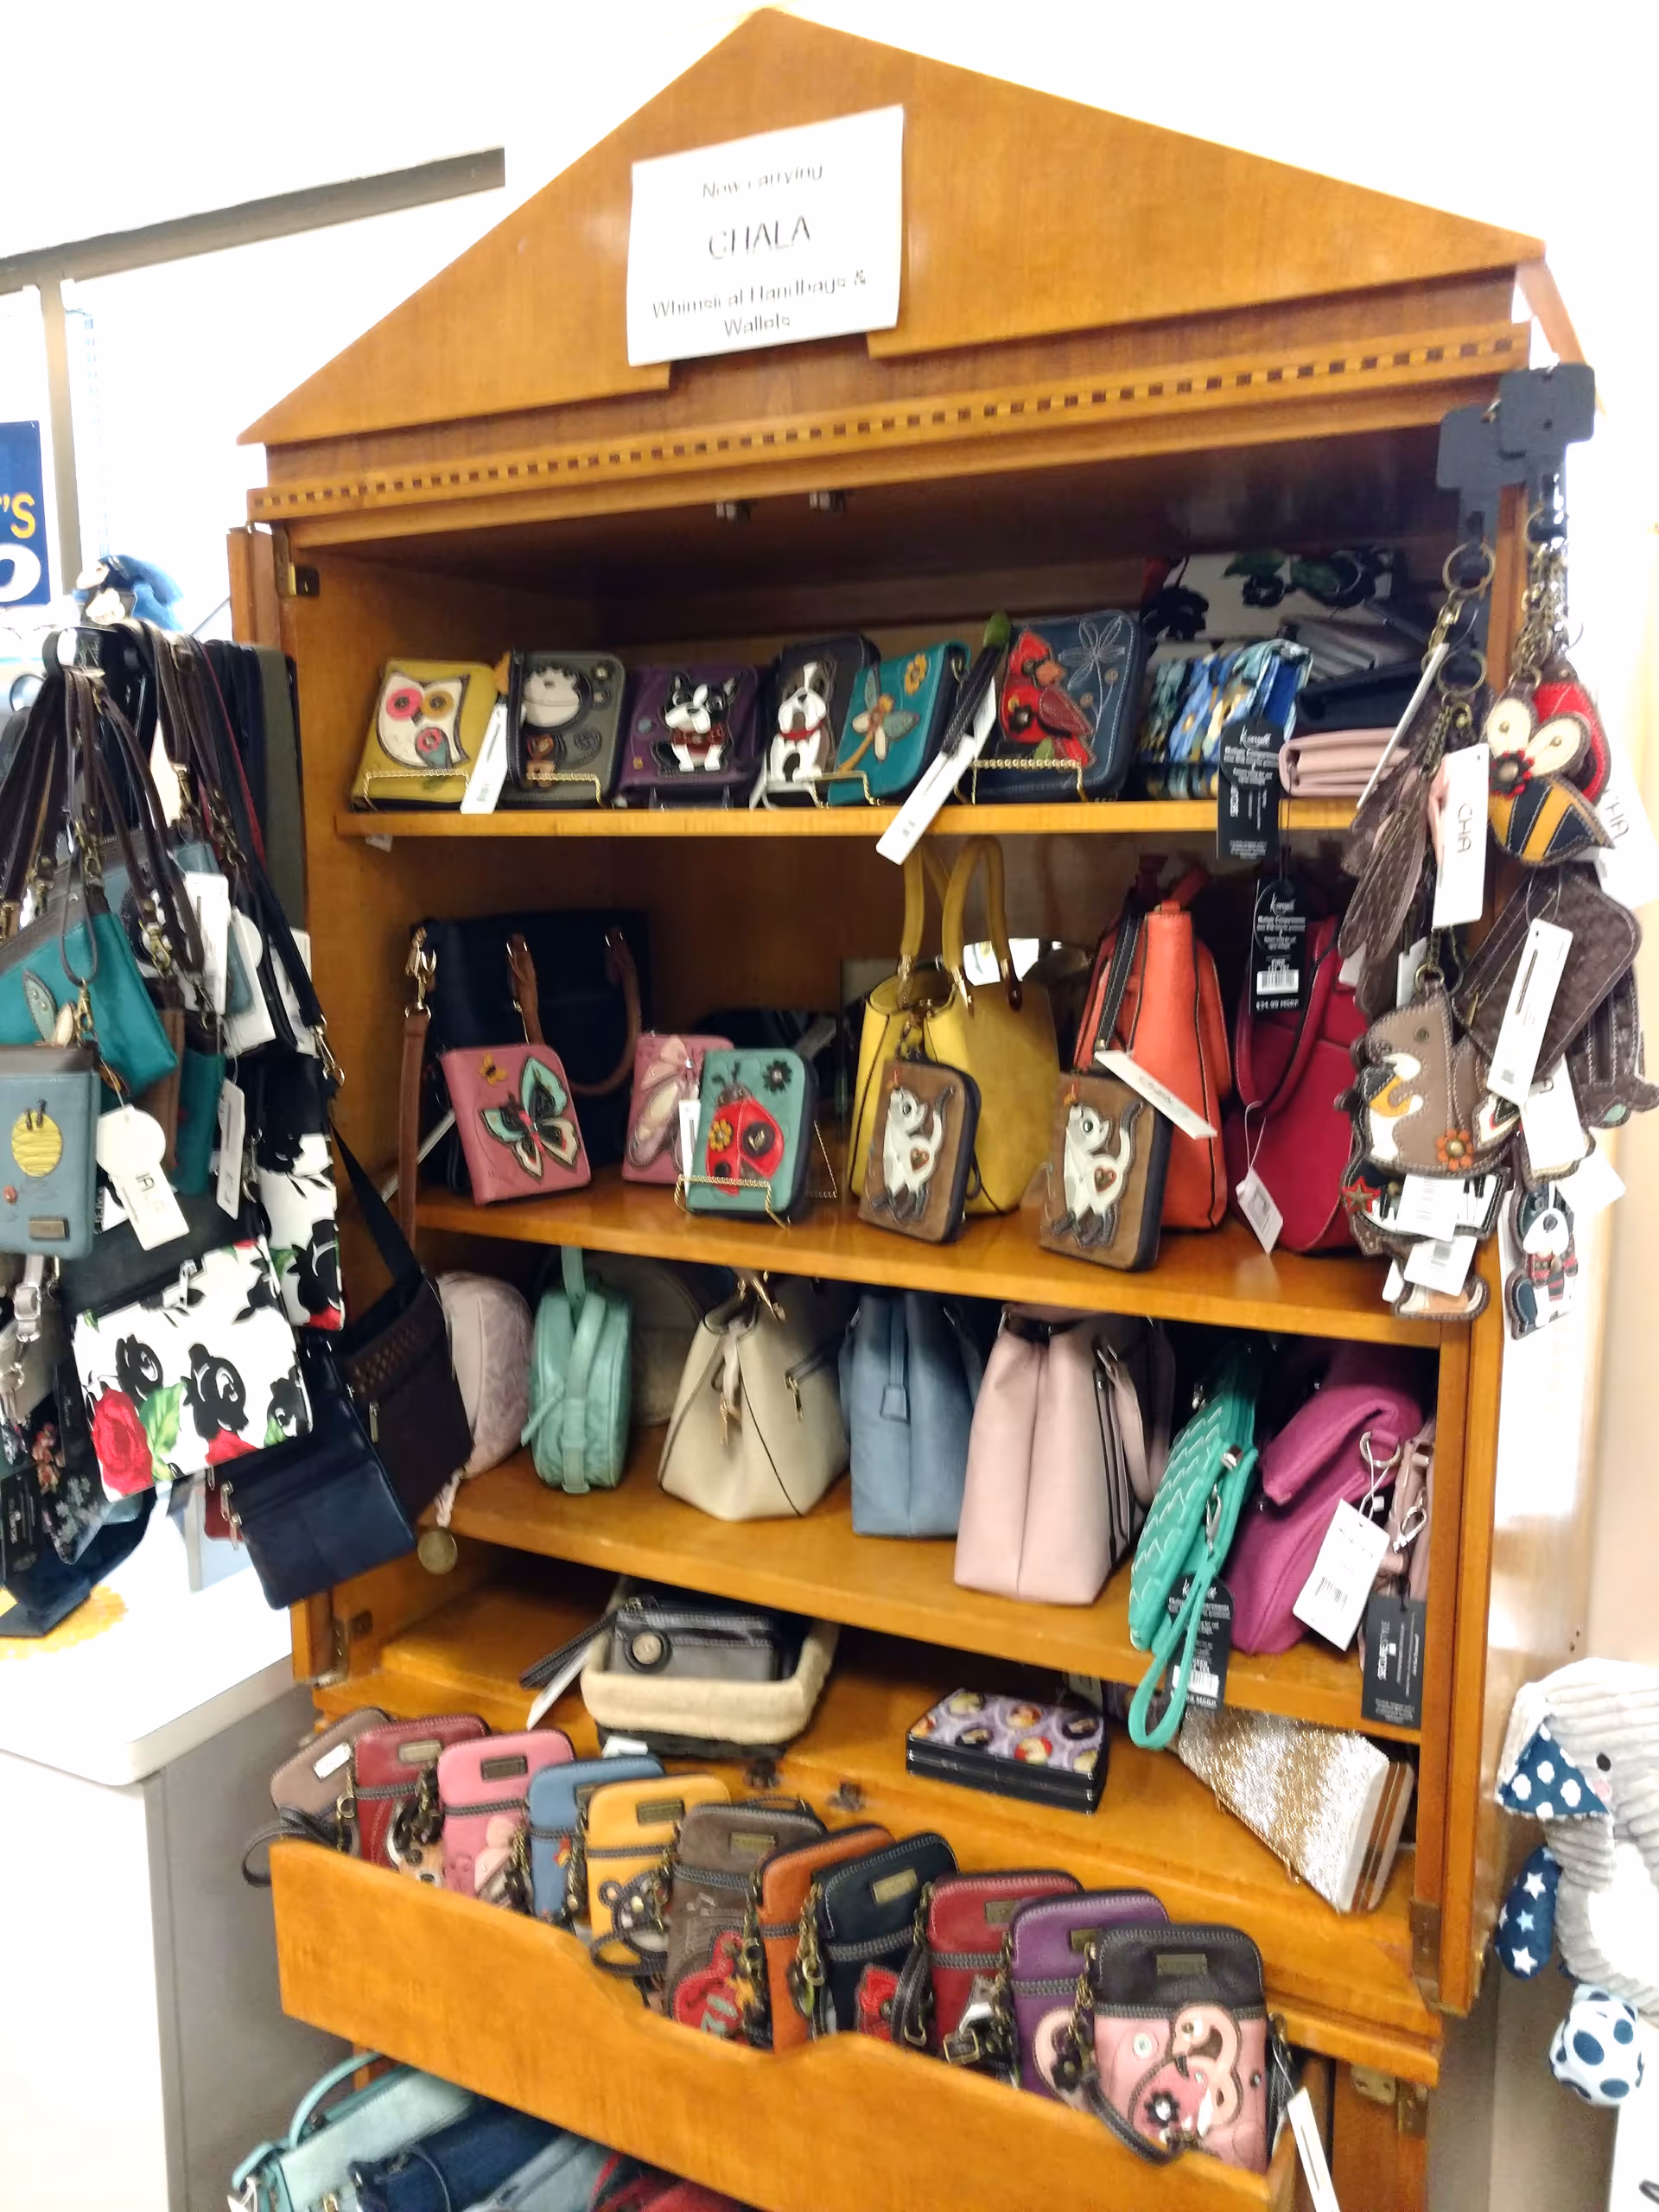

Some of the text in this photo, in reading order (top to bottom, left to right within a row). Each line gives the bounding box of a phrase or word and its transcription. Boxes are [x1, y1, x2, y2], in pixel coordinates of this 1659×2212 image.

[702, 181, 741, 200] Now
[708, 214, 811, 260] CHALA
[652, 269, 867, 319] Whimsical Handbags &
[0, 491, 35, 539] 'S
